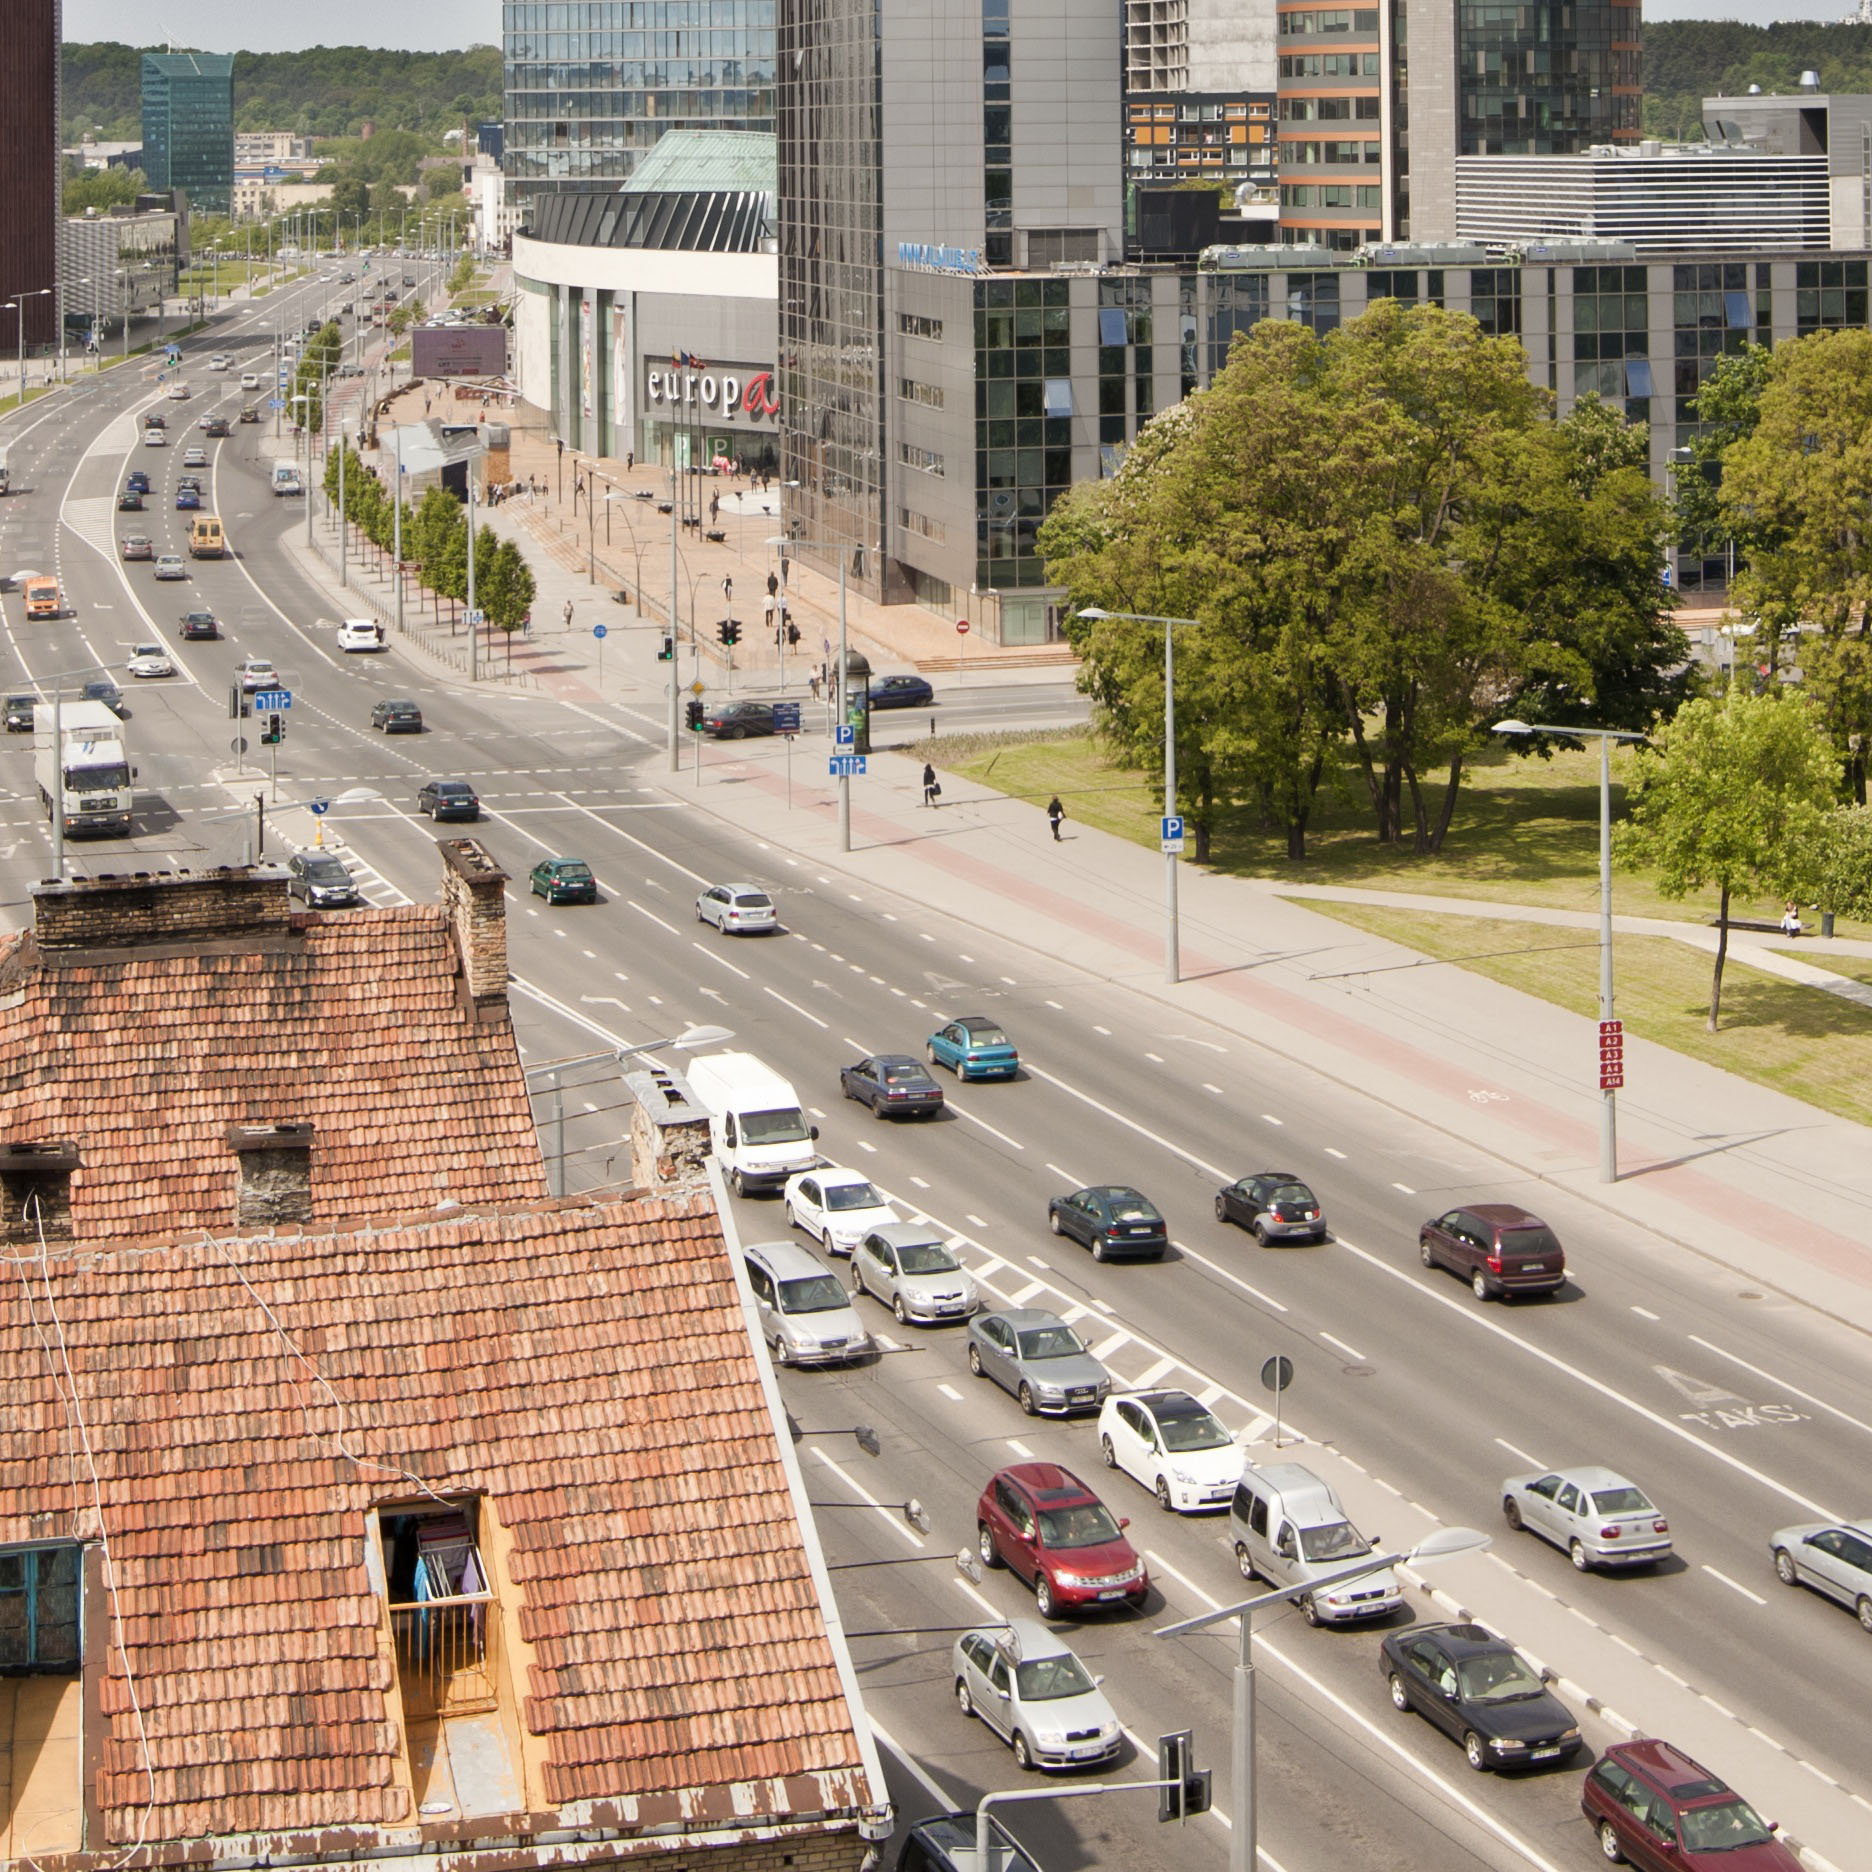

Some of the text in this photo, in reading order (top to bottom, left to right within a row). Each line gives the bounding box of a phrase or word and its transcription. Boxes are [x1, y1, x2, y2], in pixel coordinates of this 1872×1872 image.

[648, 371, 780, 417] europa
[840, 727, 851, 743] P
[1167, 819, 1180, 838] P
